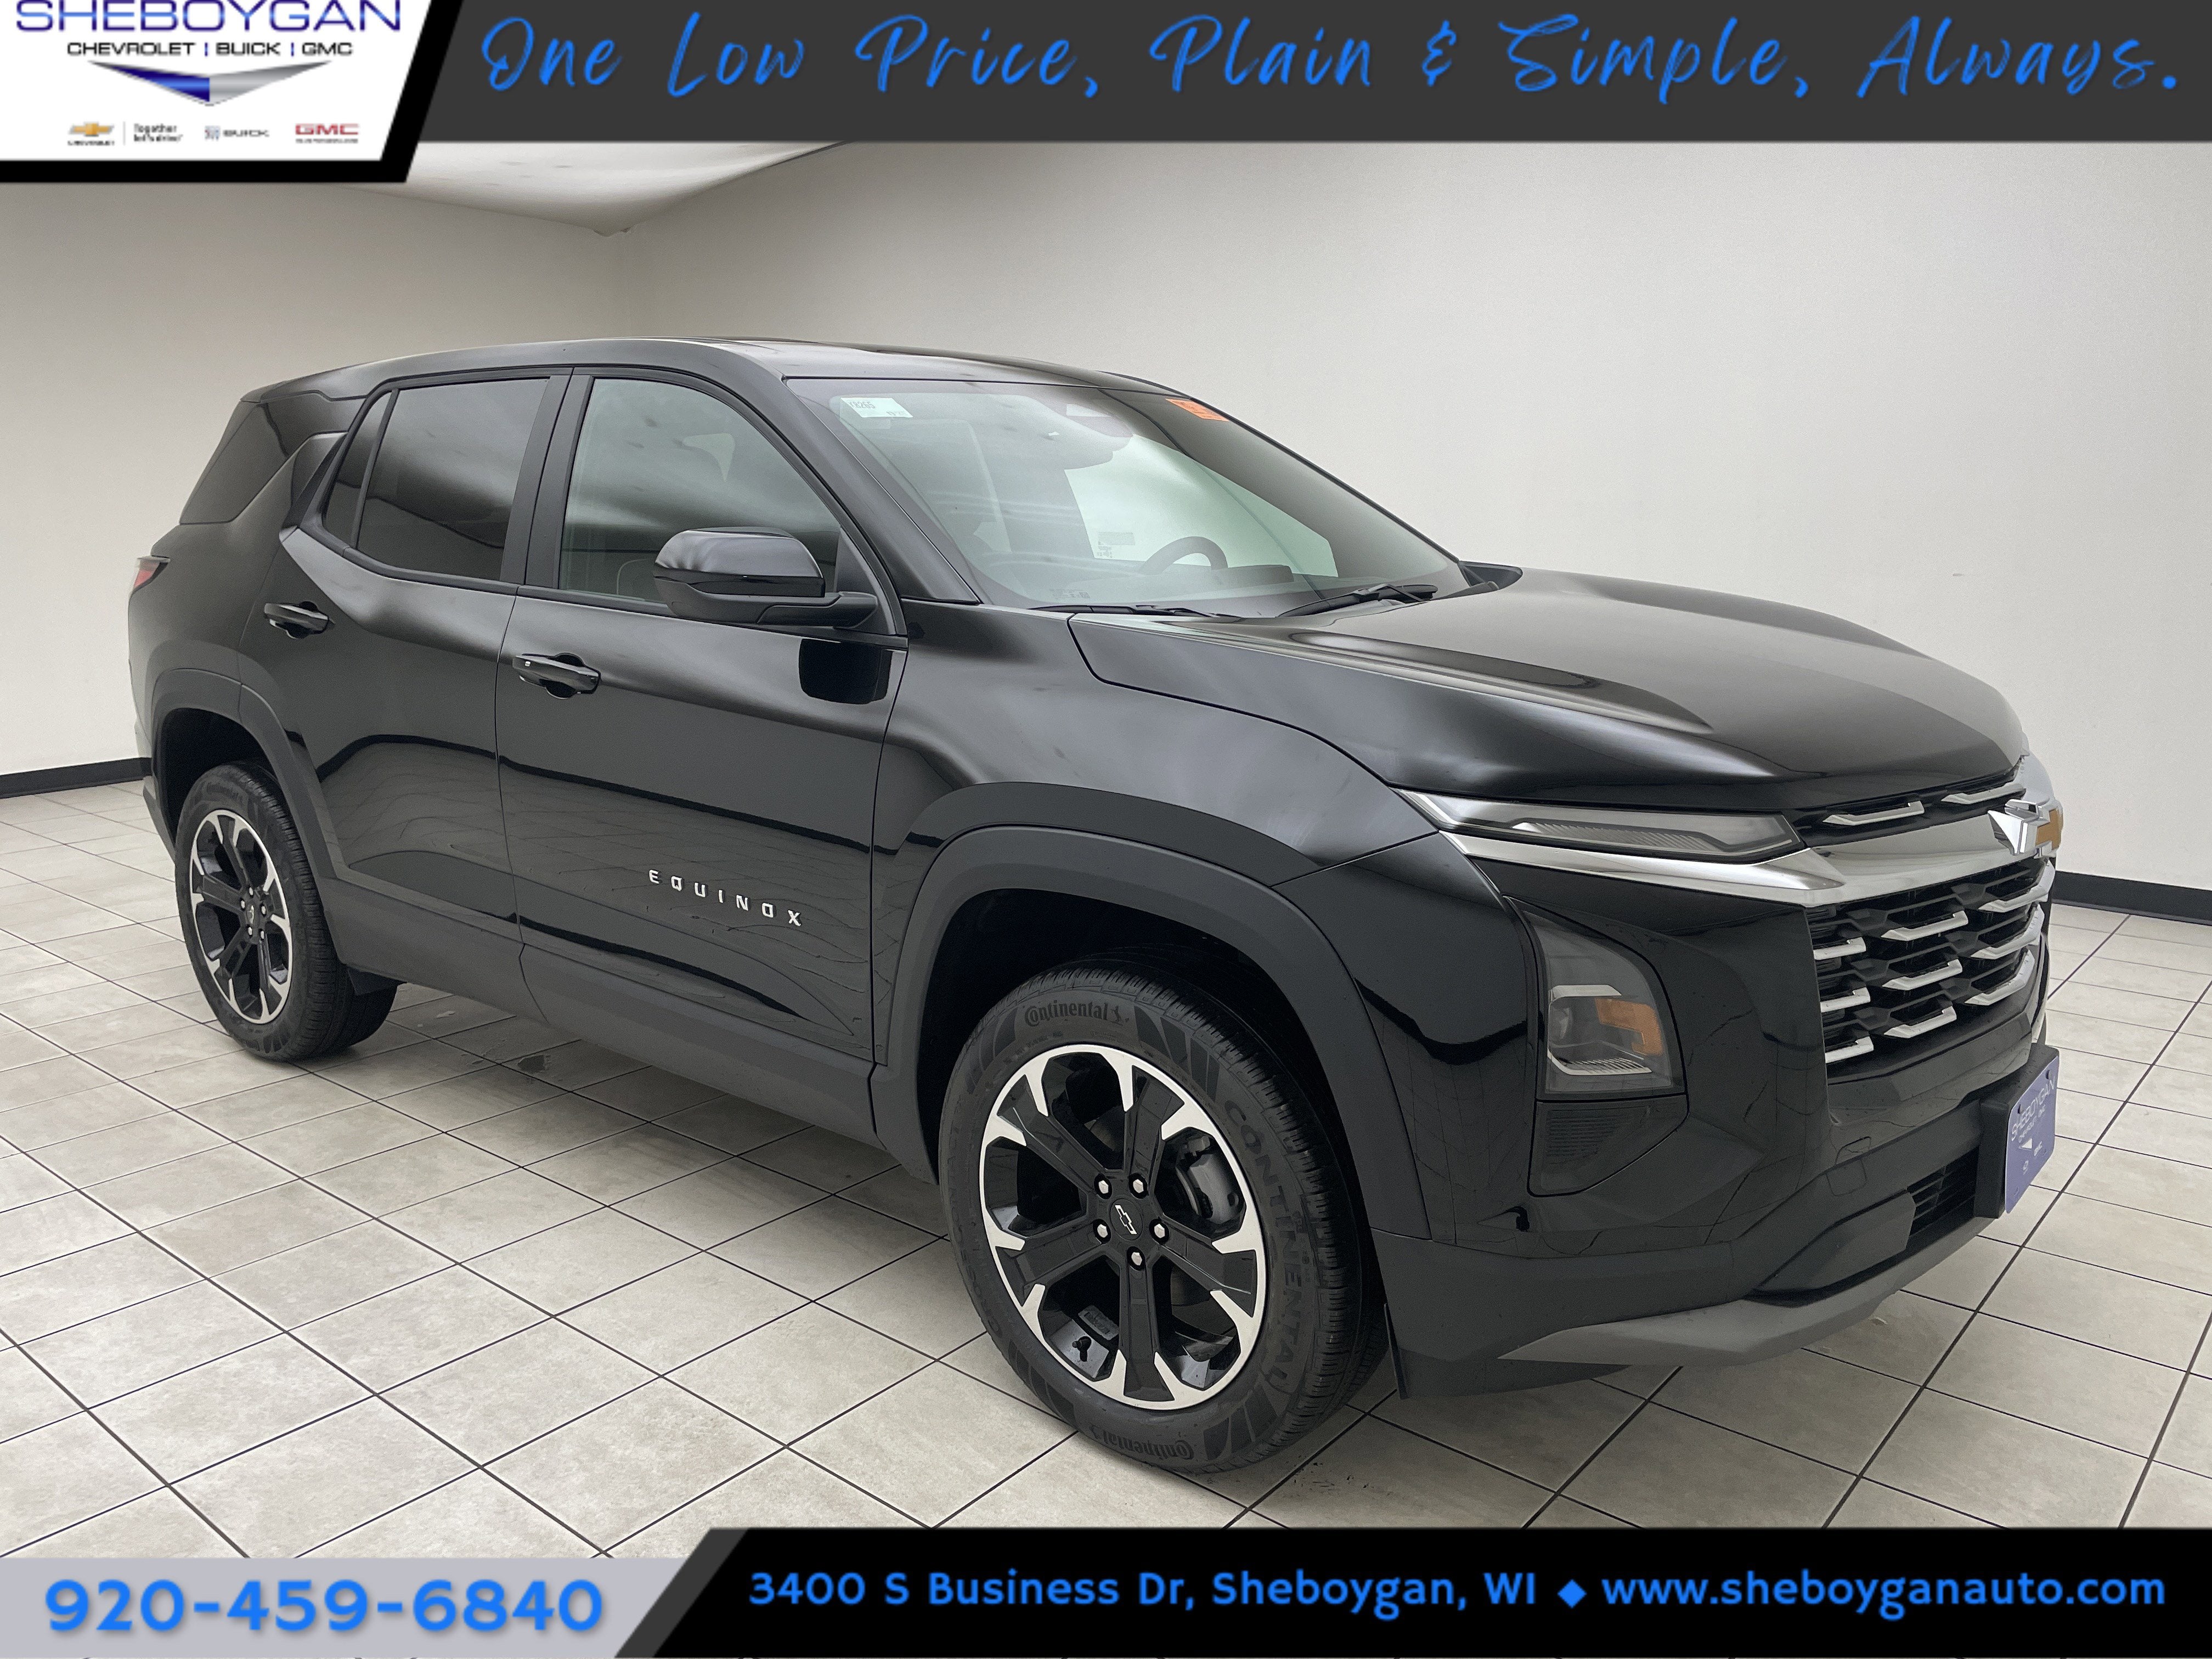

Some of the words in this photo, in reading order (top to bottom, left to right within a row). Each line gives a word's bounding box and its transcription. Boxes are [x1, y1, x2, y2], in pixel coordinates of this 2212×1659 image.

[648, 869, 802, 927] EQUINOX
[1025, 999, 1108, 1027] Continental
[2011, 1075, 2056, 1142] SHEBOYGAN
[1224, 1099, 1304, 1381] CONTINENTAL
[1103, 1429, 1195, 1461] Continental
